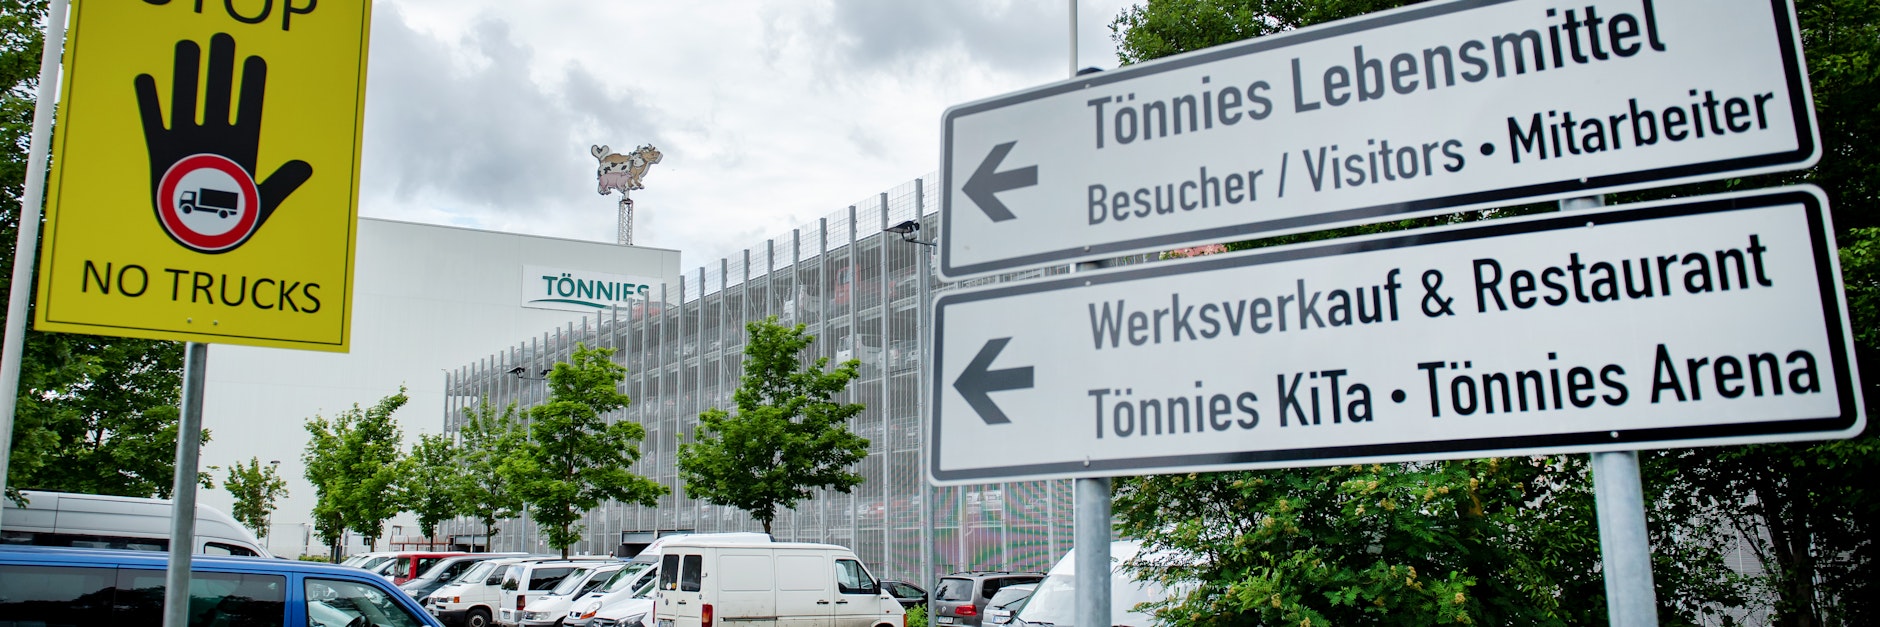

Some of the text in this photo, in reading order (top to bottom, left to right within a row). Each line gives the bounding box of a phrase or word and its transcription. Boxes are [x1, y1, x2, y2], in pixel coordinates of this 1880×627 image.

[1087, 0, 1666, 150] Tönnies Lebensmittel
[1087, 166, 1264, 226] Besucher
[1278, 152, 1288, 198] /
[1303, 138, 1465, 192] Visitors
[1507, 89, 1774, 164] Mitarbeiter
[81, 259, 322, 314] NO TRUCKS
[1088, 234, 1772, 350] Werksverkauf & Restaurant
[1088, 380, 1259, 439] Tönnies
[1277, 368, 1373, 427] KiTa
[1417, 352, 1629, 418] Tönnies
[1651, 344, 1821, 404] Arena
